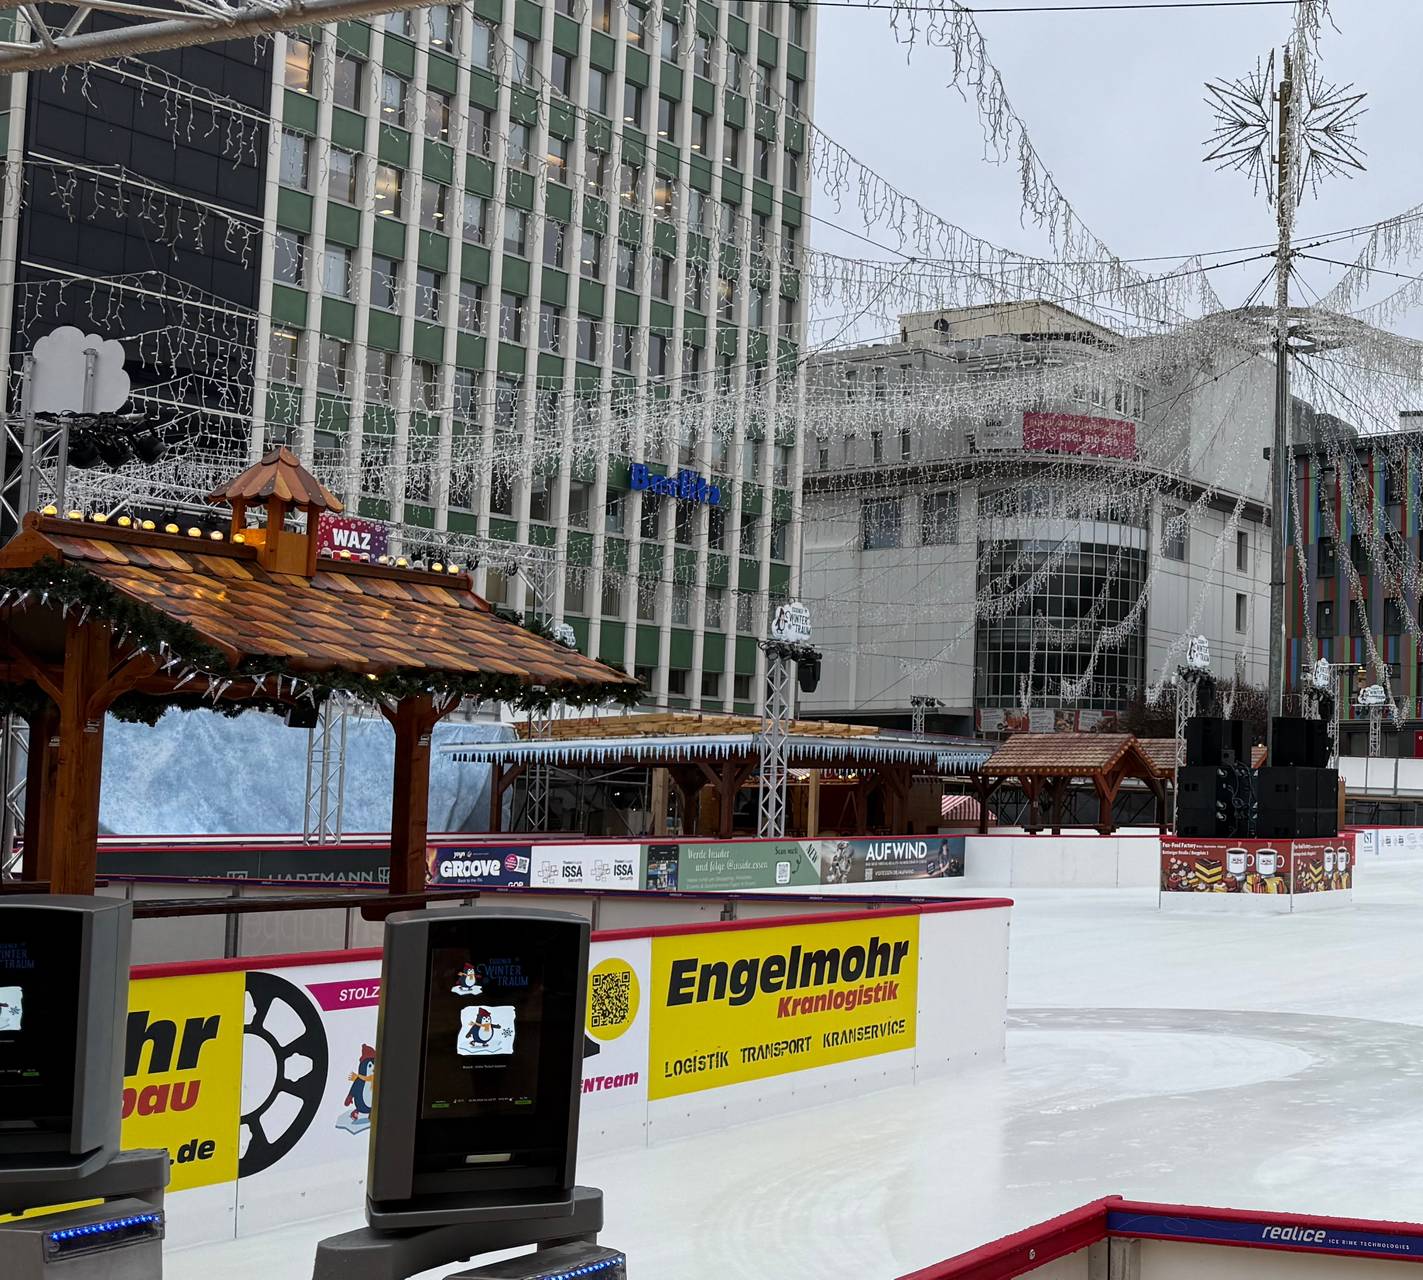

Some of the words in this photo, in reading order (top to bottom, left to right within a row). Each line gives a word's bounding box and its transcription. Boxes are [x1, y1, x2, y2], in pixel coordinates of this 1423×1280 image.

[332, 527, 371, 550] WAZ
[865, 841, 928, 861] AUFWIND
[562, 865, 583, 878] ISSA
[613, 864, 634, 877] ISSA
[666, 936, 909, 1007] Engelmohr
[338, 985, 380, 1002] STOLZ
[776, 980, 898, 1019] Kranlogistik
[664, 1049, 729, 1078] LOGISTIK
[740, 1036, 812, 1063] TRANSPORT
[822, 1016, 906, 1048] KRANSERVICE
[579, 1071, 639, 1094] NTeam
[168, 1138, 216, 1165] .de
[1261, 1225, 1327, 1243] realice
[1360, 1241, 1410, 1250] TECHNOLOGIES
